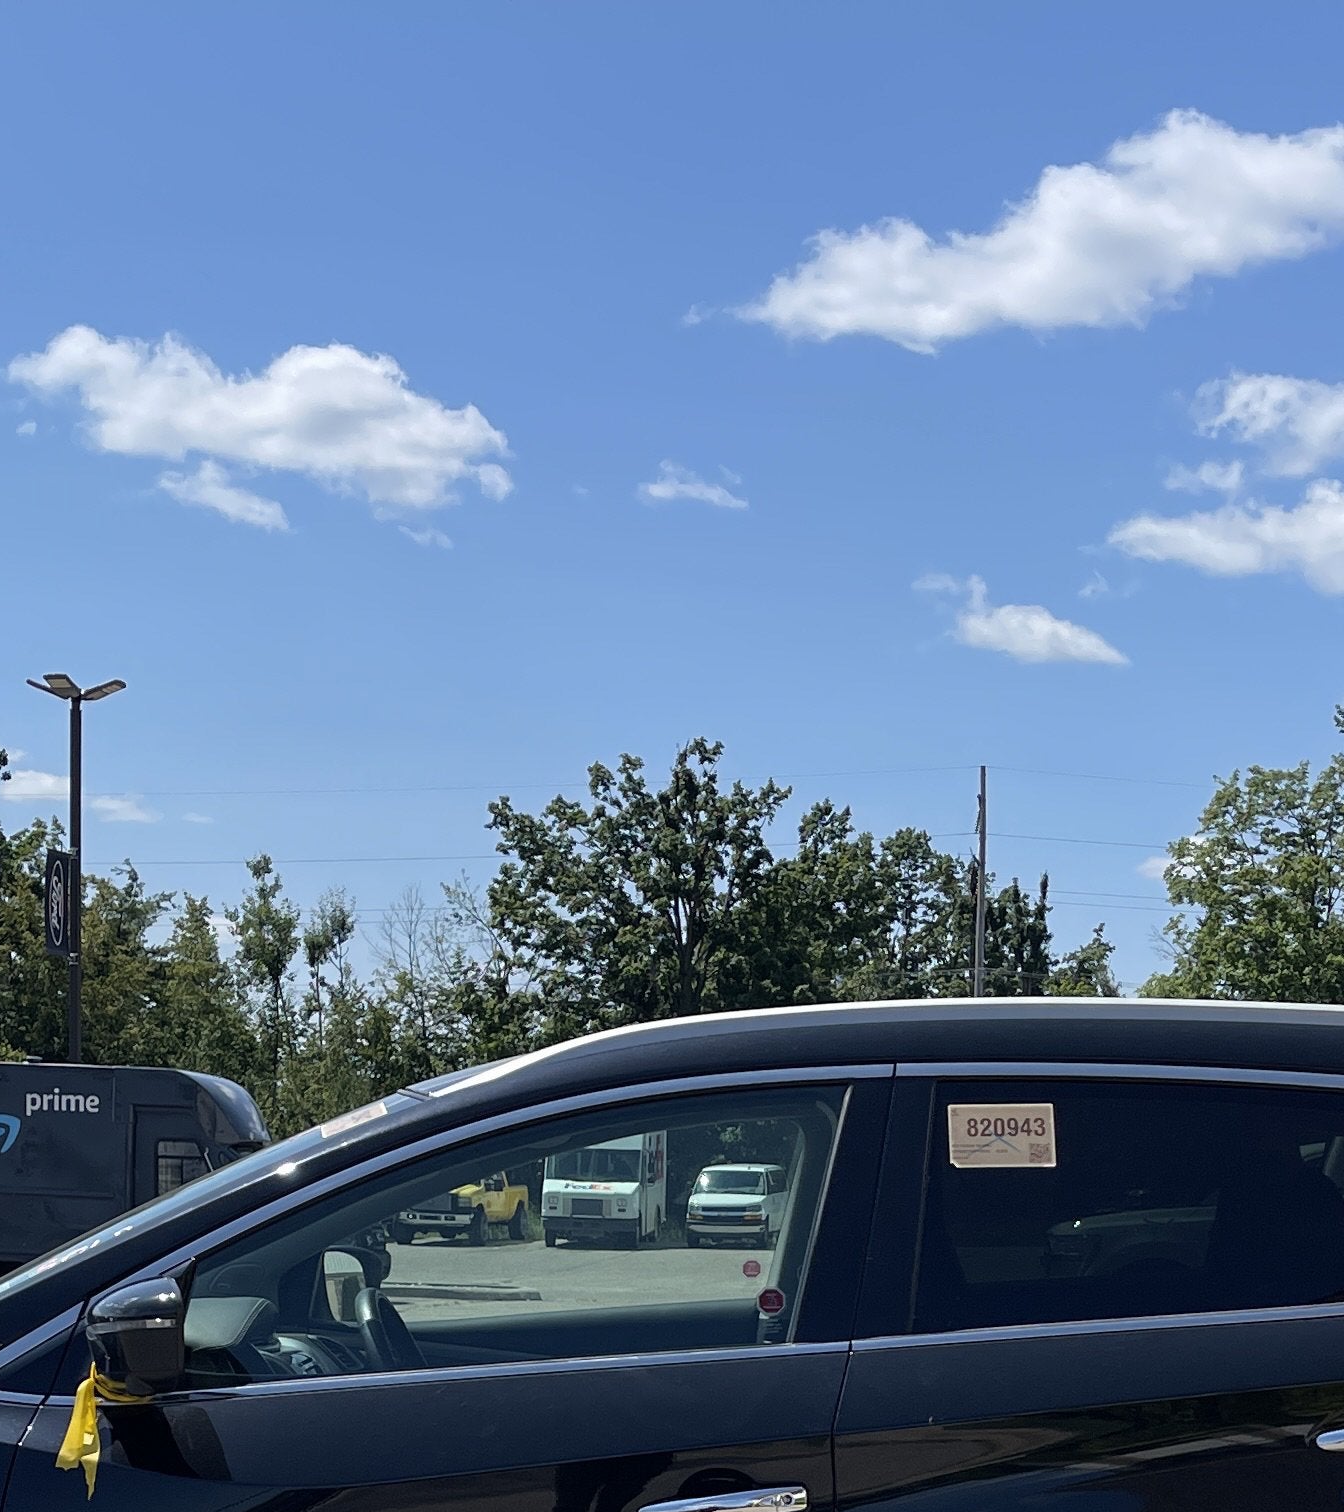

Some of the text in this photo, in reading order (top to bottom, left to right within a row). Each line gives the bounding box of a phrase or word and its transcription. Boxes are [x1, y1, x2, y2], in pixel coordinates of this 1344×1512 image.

[25, 1087, 100, 1117] prime
[966, 1117, 1047, 1138] 820943
[564, 1182, 613, 1191] FedEx
